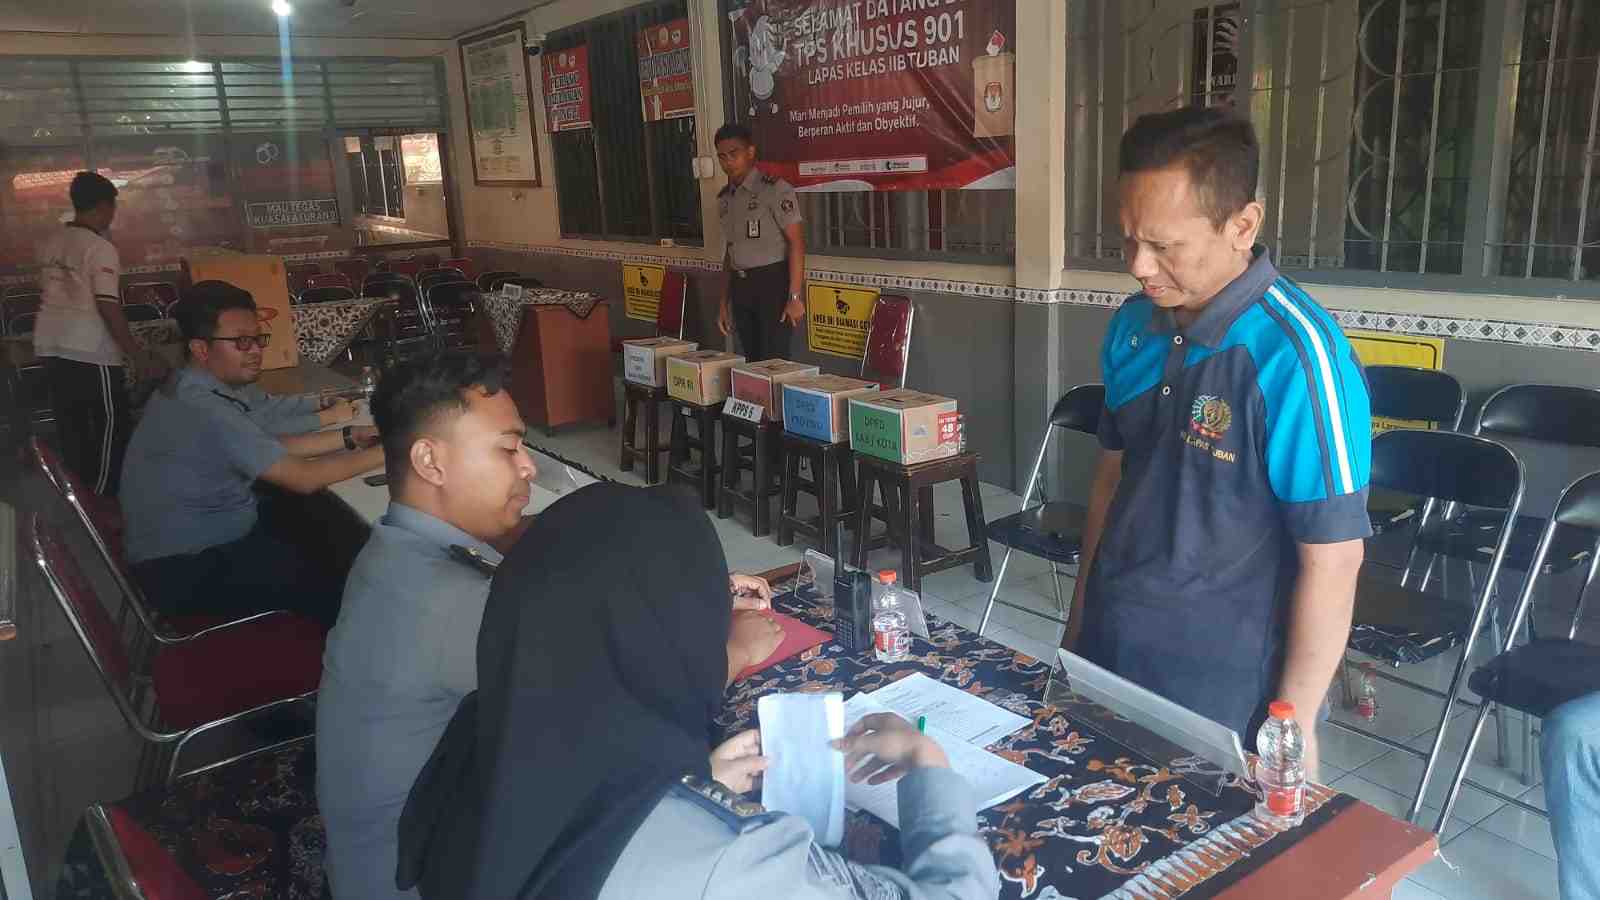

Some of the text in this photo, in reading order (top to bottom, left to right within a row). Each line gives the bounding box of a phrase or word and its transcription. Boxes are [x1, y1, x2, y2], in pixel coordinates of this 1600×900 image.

[794, 3, 861, 36] SELAMAT
[793, 10, 964, 66] TPS KHUSUS 901
[808, 65, 844, 85] LAPAS
[846, 57, 886, 79] KELAS
[789, 96, 930, 122] Mari Menjadi Pemilih yang Jujur,
[798, 115, 920, 138] Berperan Aktif dan Obyektif.
